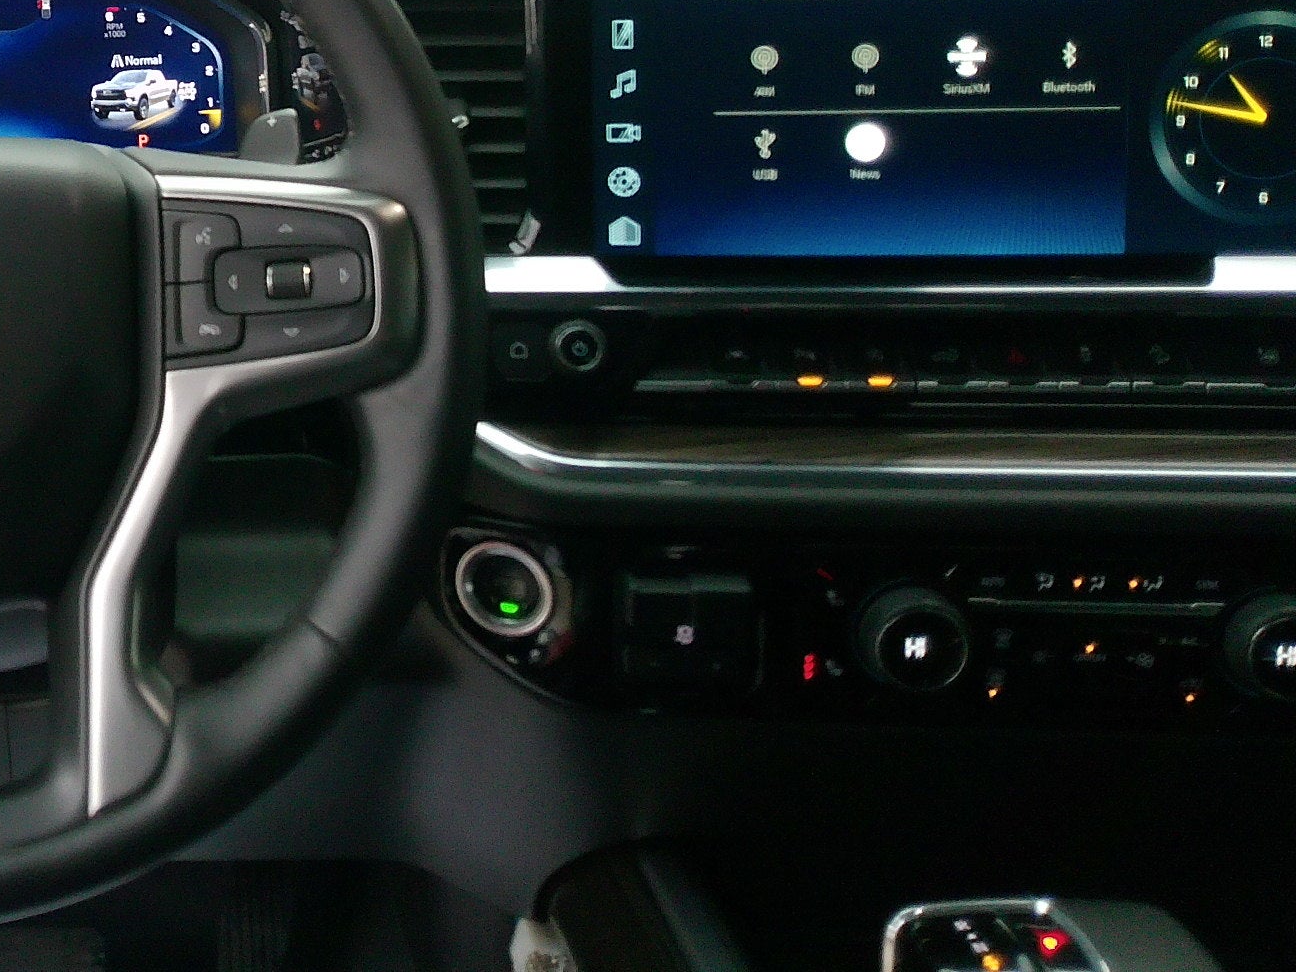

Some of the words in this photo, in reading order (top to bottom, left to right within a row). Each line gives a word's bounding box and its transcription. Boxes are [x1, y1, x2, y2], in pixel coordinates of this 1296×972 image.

[137, 12, 146, 23] 5
[164, 25, 173, 36] 4
[1259, 35, 1274, 47] 12
[1219, 47, 1229, 60] 11
[124, 54, 163, 66] Normal
[205, 65, 214, 77] 2
[942, 82, 991, 95] SiriusXM
[1042, 80, 1096, 93] Bluetooth
[1184, 76, 1199, 89] 10
[207, 97, 214, 108] 1
[138, 134, 150, 148] P
[850, 168, 881, 180] News
[1216, 180, 1226, 194] 7
